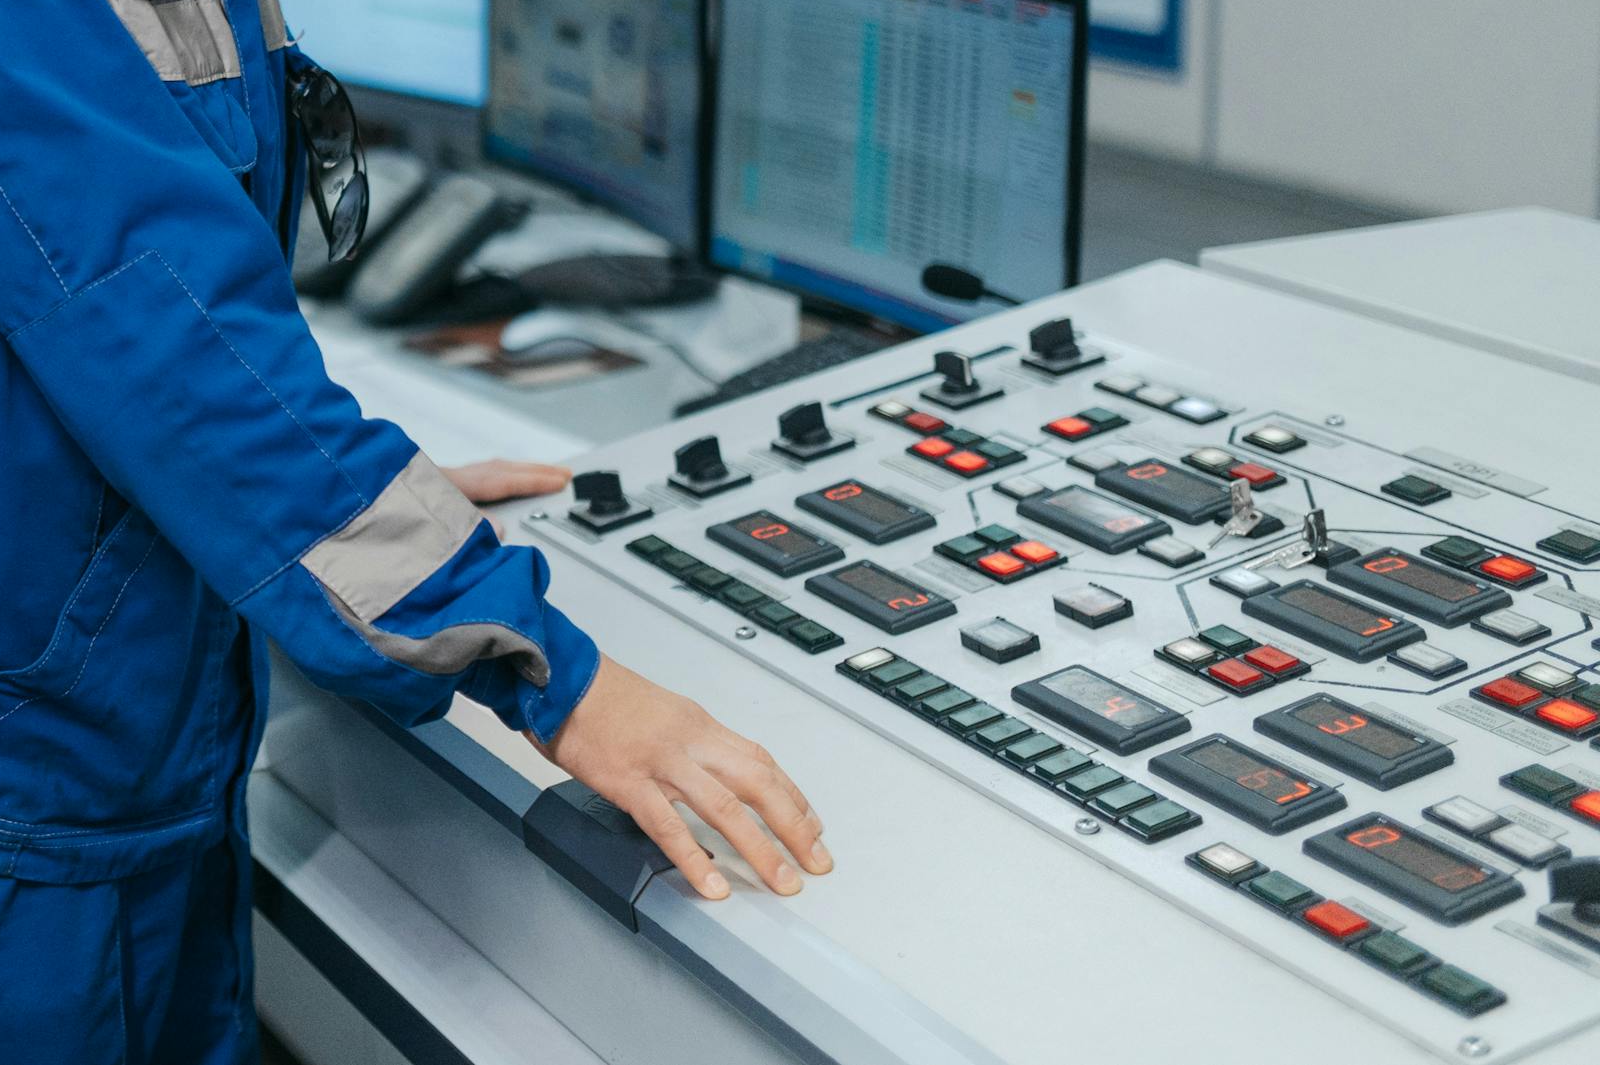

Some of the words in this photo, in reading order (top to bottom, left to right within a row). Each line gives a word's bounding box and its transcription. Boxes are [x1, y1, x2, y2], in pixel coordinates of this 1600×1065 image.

[1128, 464, 1168, 480] 0
[824, 483, 863, 501] 0
[750, 522, 790, 541] 0
[1363, 556, 1409, 574] 0
[887, 593, 929, 610] 2
[1361, 617, 1394, 637] 7
[1317, 714, 1368, 735] 3
[1347, 825, 1401, 850] 0
